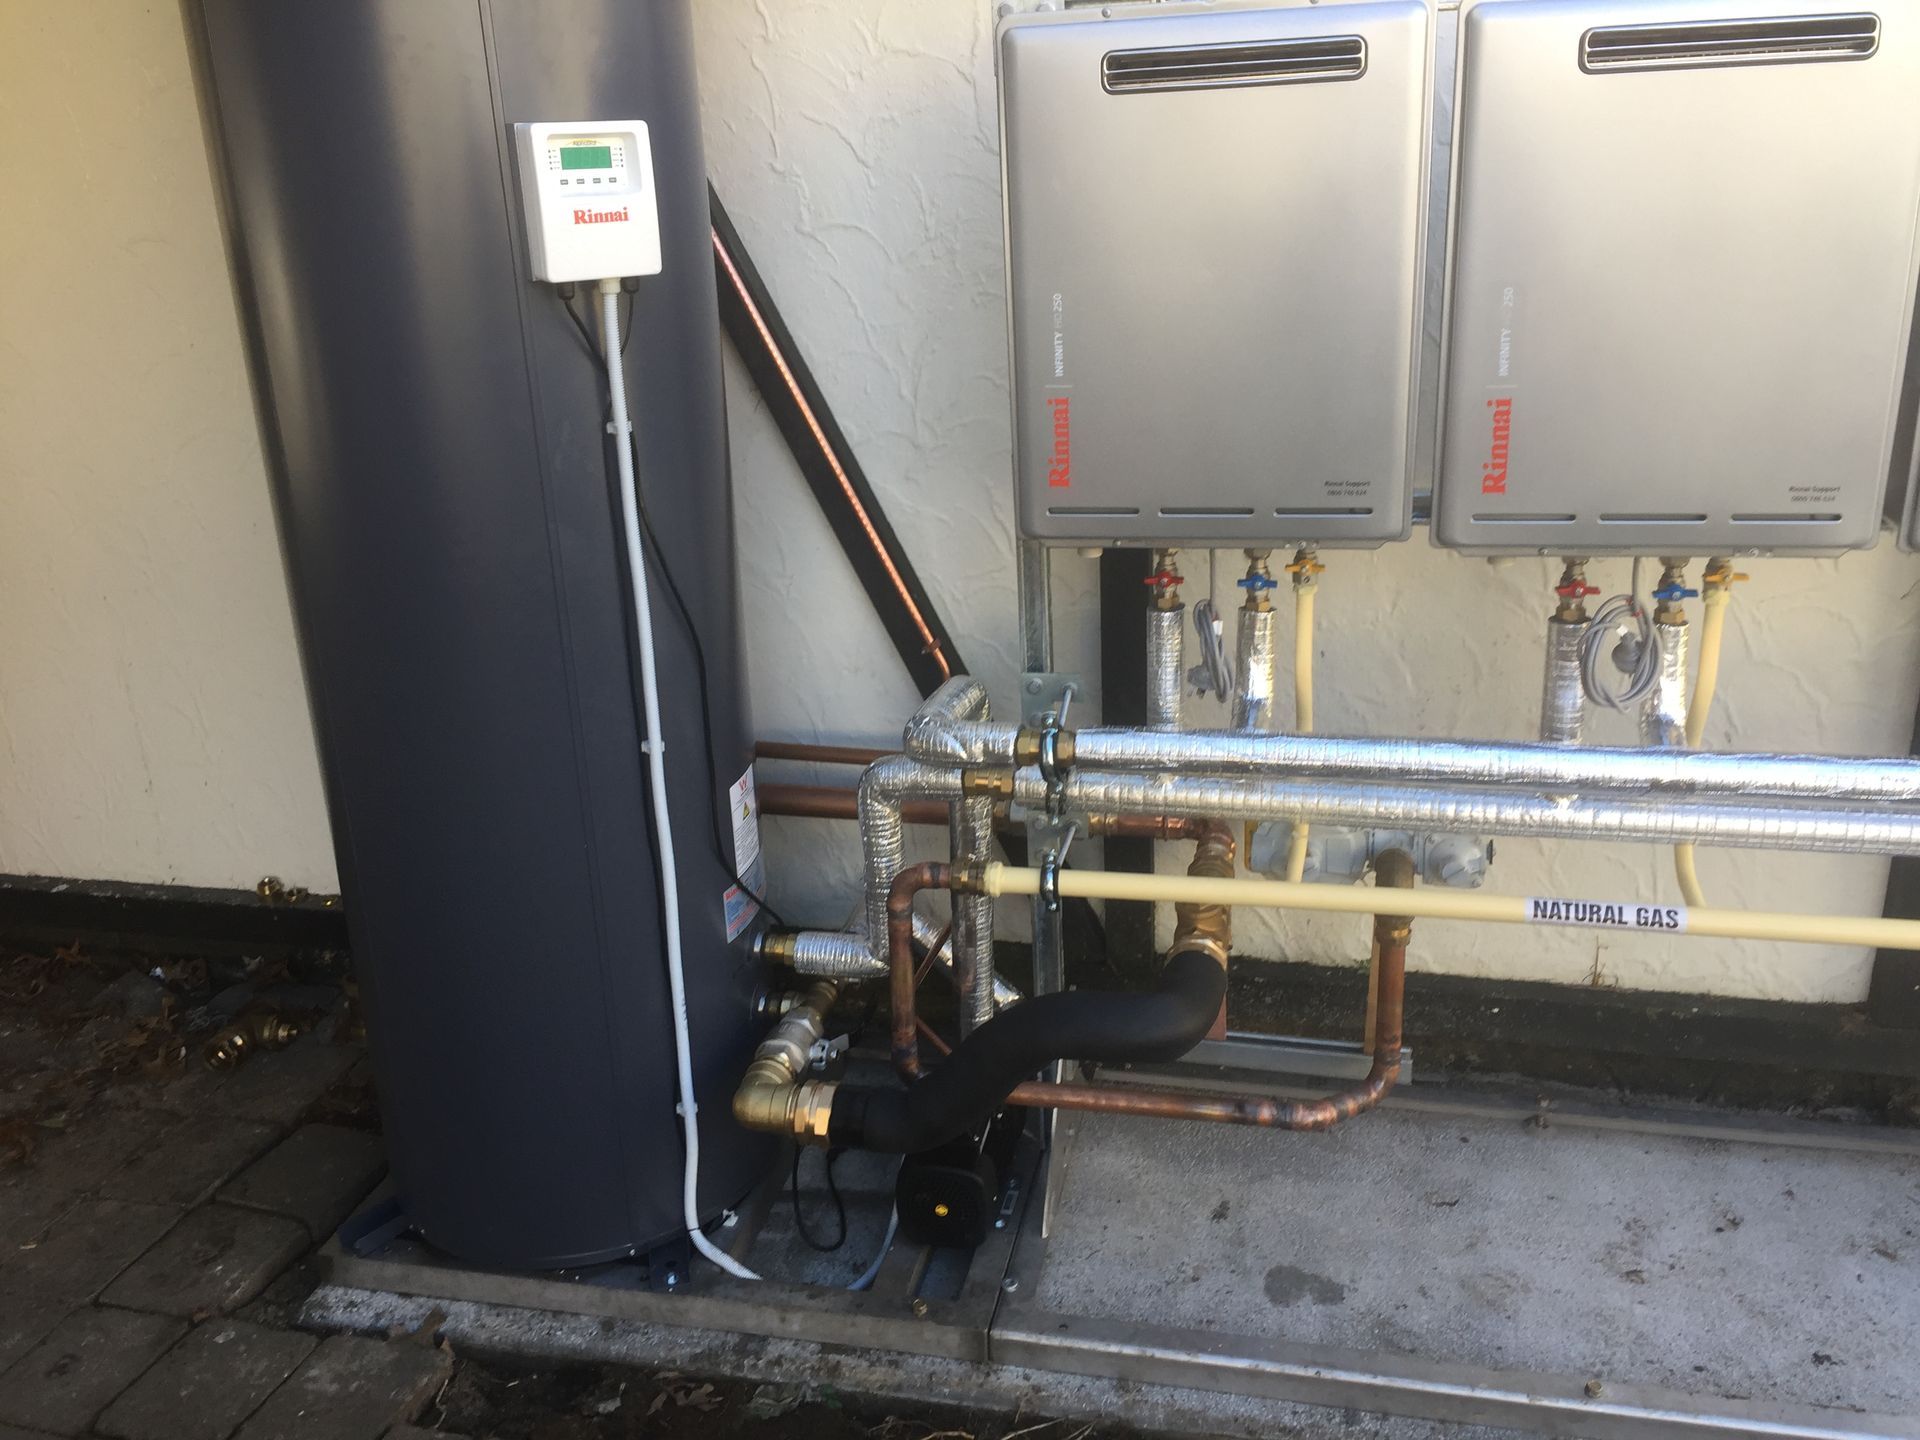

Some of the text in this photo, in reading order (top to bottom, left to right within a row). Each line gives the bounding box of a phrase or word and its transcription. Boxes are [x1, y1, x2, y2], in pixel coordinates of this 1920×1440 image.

[573, 206, 629, 225] Rinnai
[1054, 331, 1064, 377] INFINITY
[1498, 328, 1512, 377] INFINITY
[1048, 397, 1070, 488] Rinnai
[1481, 397, 1513, 495] Rinnai
[1533, 900, 1679, 929] NATURAL GAS
